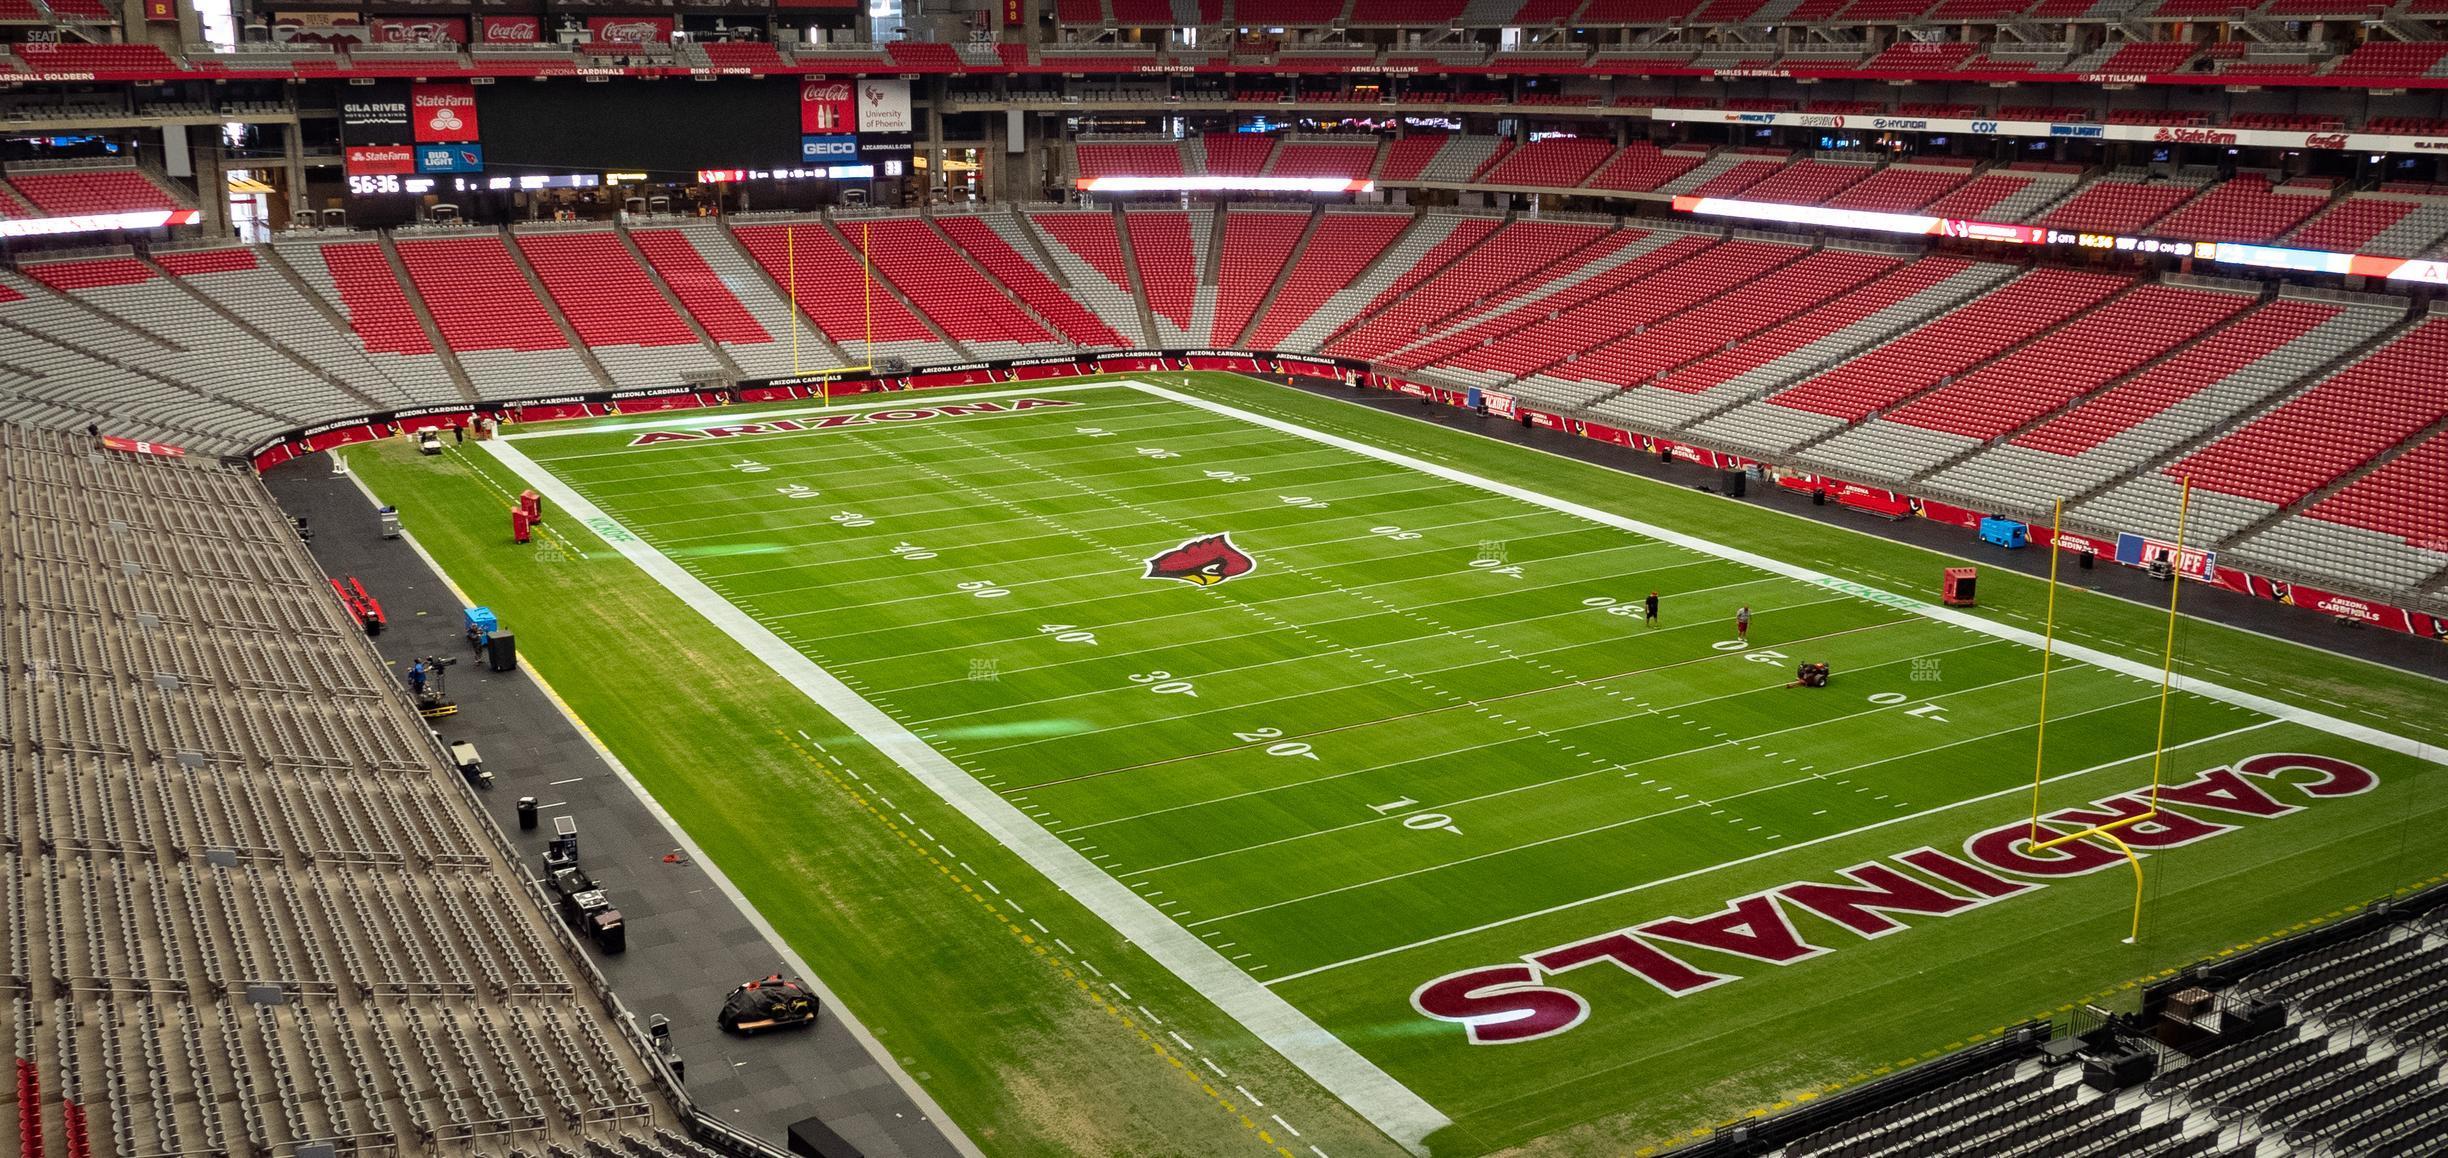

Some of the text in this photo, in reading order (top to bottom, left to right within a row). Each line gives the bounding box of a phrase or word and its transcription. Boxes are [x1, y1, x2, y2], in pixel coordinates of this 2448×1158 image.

[155, 3, 166, 15] B
[487, 22, 534, 41] Coca-Cola
[44, 72, 95, 81] GOLDBERG
[690, 67, 710, 75] RING
[723, 67, 751, 75] HONOR
[1714, 69, 1742, 77] CHARLES
[2089, 74, 2108, 82] PAT
[2109, 74, 2147, 83] TILLMAN
[804, 84, 850, 102] Coca-Cola
[344, 103, 406, 112] GILA RIVER
[866, 110, 902, 120] University
[866, 119, 903, 127] of Phoenix
[1888, 120, 1927, 129] HYUNDAI
[1971, 122, 1998, 133] COX
[2073, 126, 2101, 137] LIGHT
[803, 142, 855, 154] GEICO
[428, 151, 449, 159] BUD
[425, 158, 453, 166] LIGHT
[350, 175, 399, 193] 56:36
[2032, 229, 2042, 242] 7
[1096, 352, 1124, 360] ARIZONA
[1216, 351, 1254, 359] CARDINALS
[1277, 353, 1335, 365] ARIZONA CARDINALS
[1011, 356, 1076, 367] ARIZONA CARDINALS
[922, 363, 989, 374] ARIZONA CARDINALS
[769, 375, 842, 386] ARIZONA CARDIALS
[612, 387, 690, 399] ARIZONA CARDINALS
[503, 395, 585, 408] ARIONA CARDINALS
[395, 404, 475, 419] ARIZONA CARDINALS
[304, 417, 369, 436] ARIZONA CARDINALS
[627, 398, 1083, 447] ARIZONA
[731, 460, 770, 473] 10
[777, 484, 820, 499] 20
[831, 510, 875, 527] 30
[2060, 534, 2089, 546] ARIZONA
[890, 543, 938, 560] 40
[2143, 544, 2202, 573] KIKOFF
[958, 581, 1011, 598] 50
[2330, 597, 2368, 611] ARIZONA
[1037, 624, 1095, 642] 40
[1711, 640, 1788, 663] 20
[1128, 671, 1193, 693] 30
[1868, 691, 1949, 718] 10
[1233, 727, 1312, 756] 20
[1366, 795, 1452, 830] 10
[1410, 752, 2380, 1046] CARDINALS
